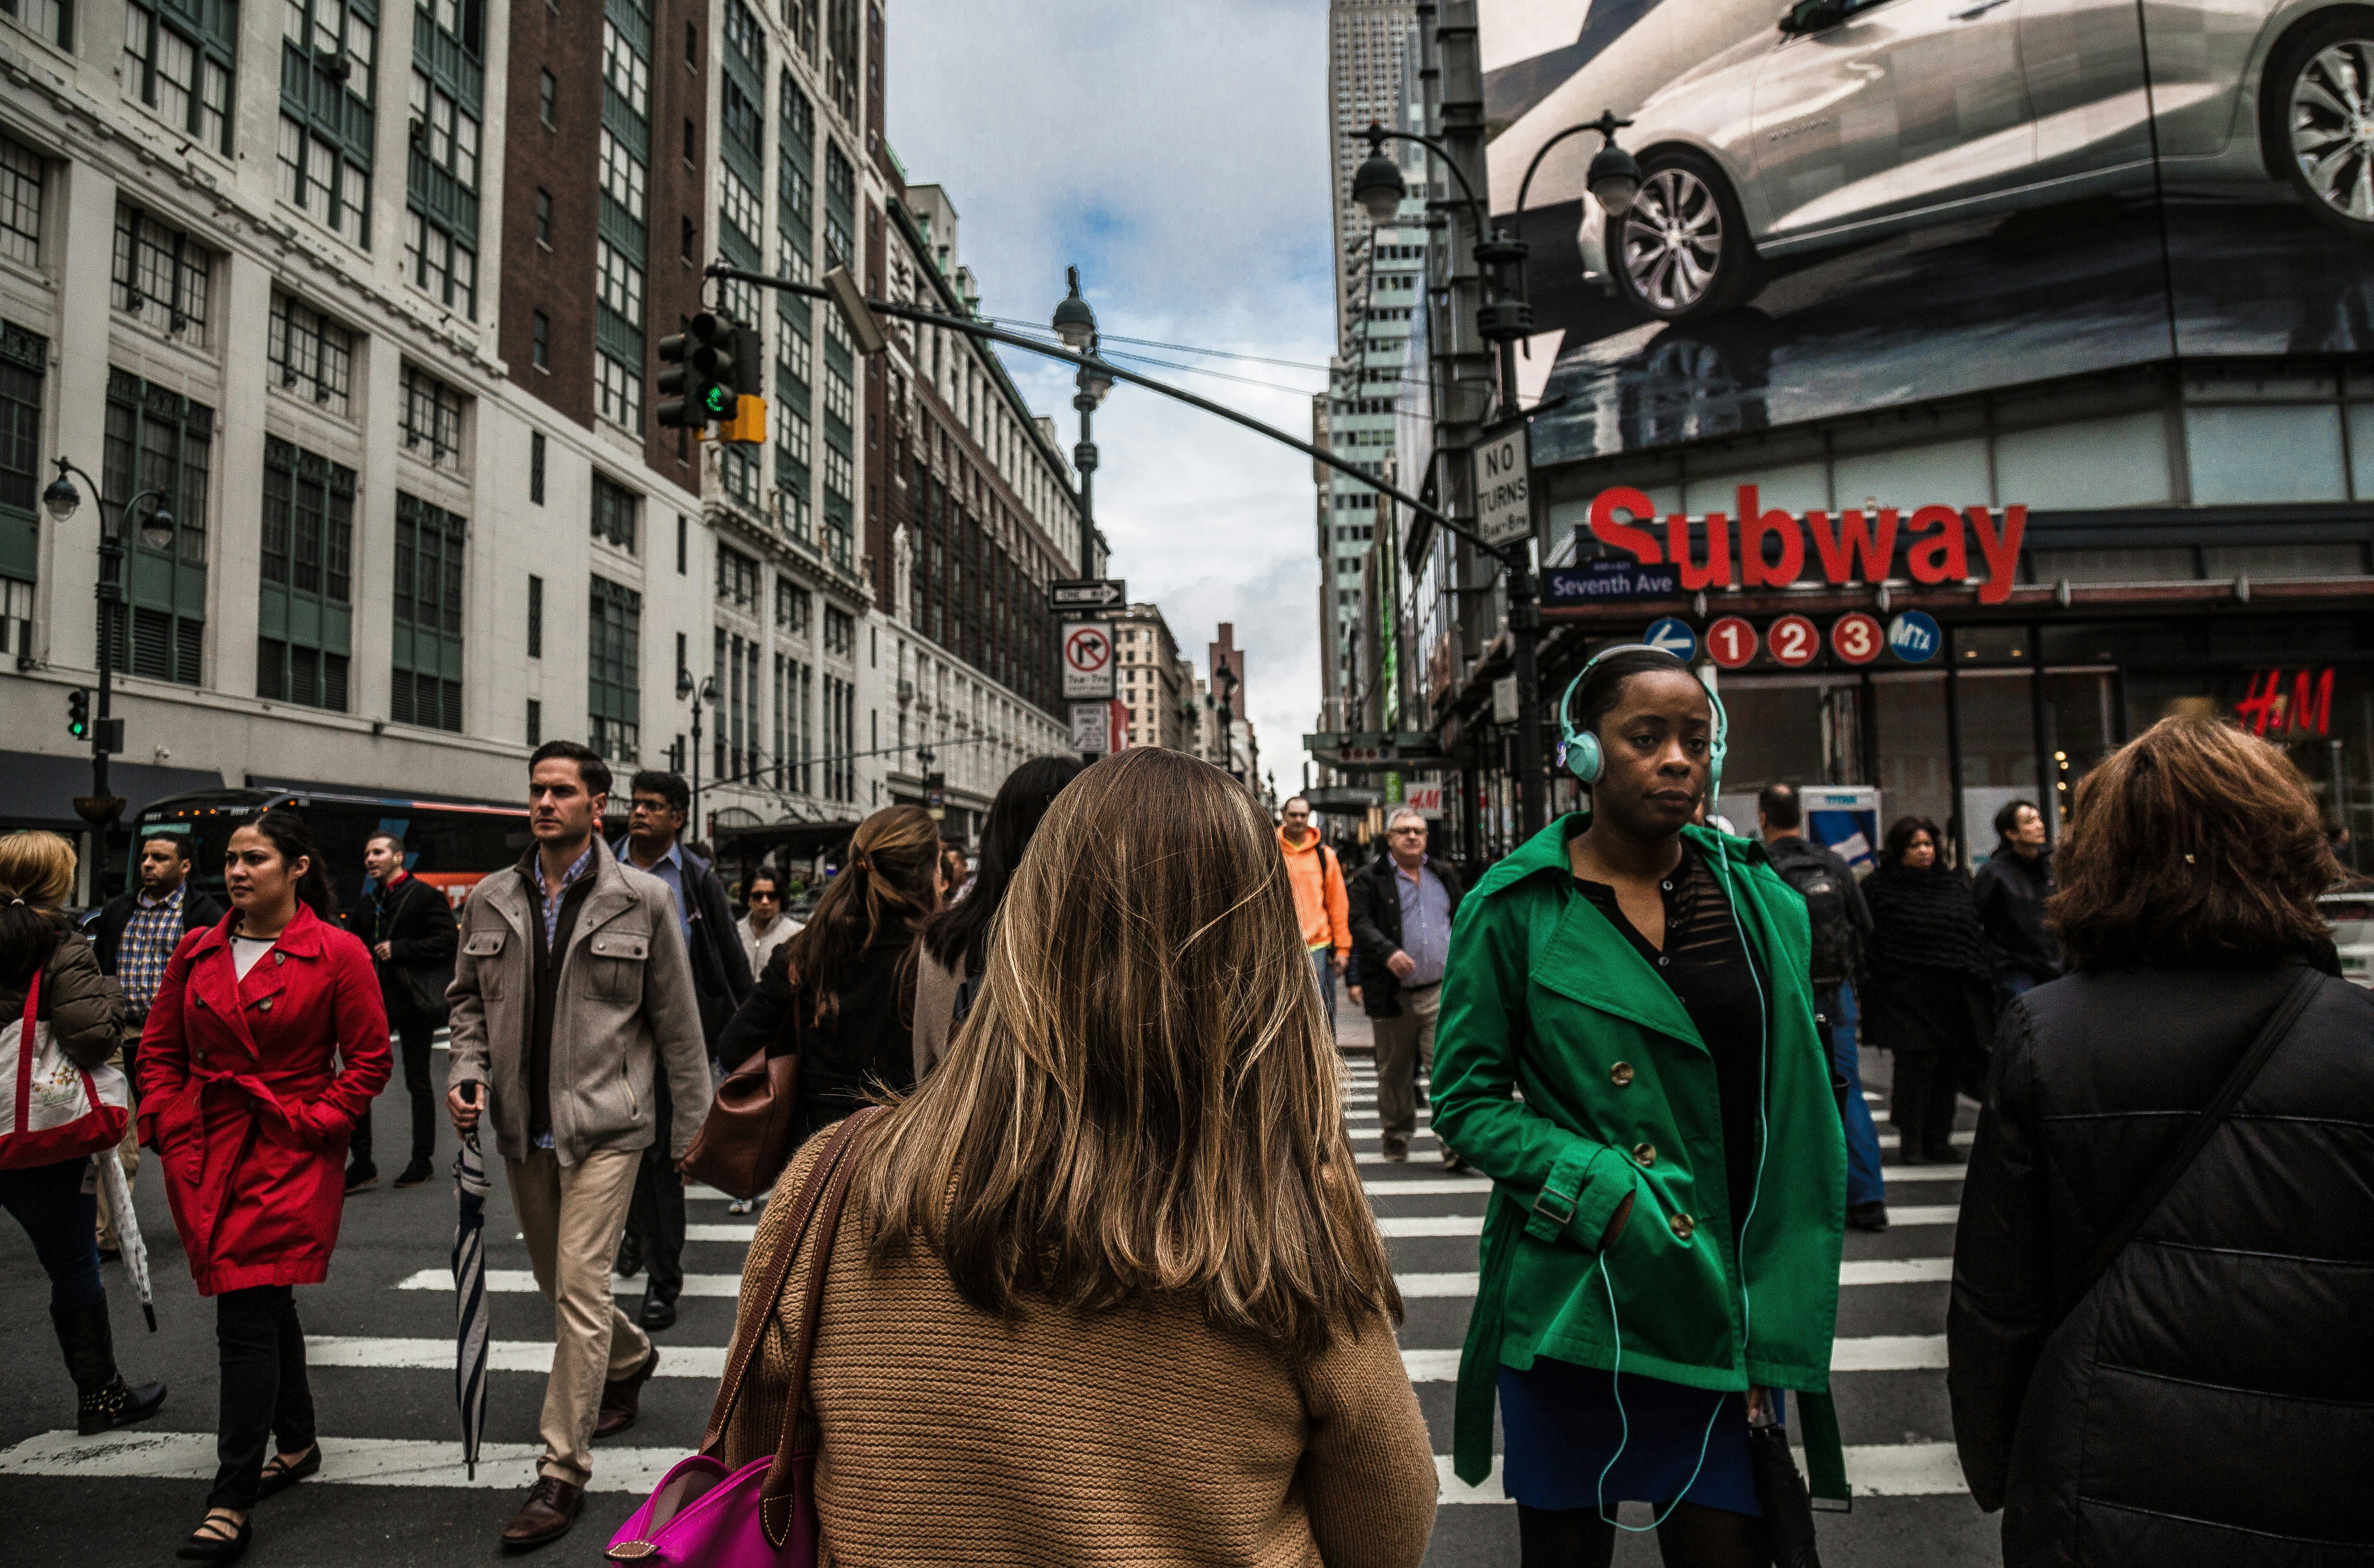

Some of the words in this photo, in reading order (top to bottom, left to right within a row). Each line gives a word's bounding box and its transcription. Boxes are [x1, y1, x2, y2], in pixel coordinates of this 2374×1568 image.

[1486, 443, 1514, 478] NO
[1478, 477, 1527, 514] TURNS
[1591, 484, 2026, 604] Subway
[1554, 574, 1631, 596] Seventh
[1636, 573, 1673, 593] Ave
[1721, 625, 1739, 659] 1
[1780, 623, 1807, 658] 2
[1845, 620, 1871, 656] 3
